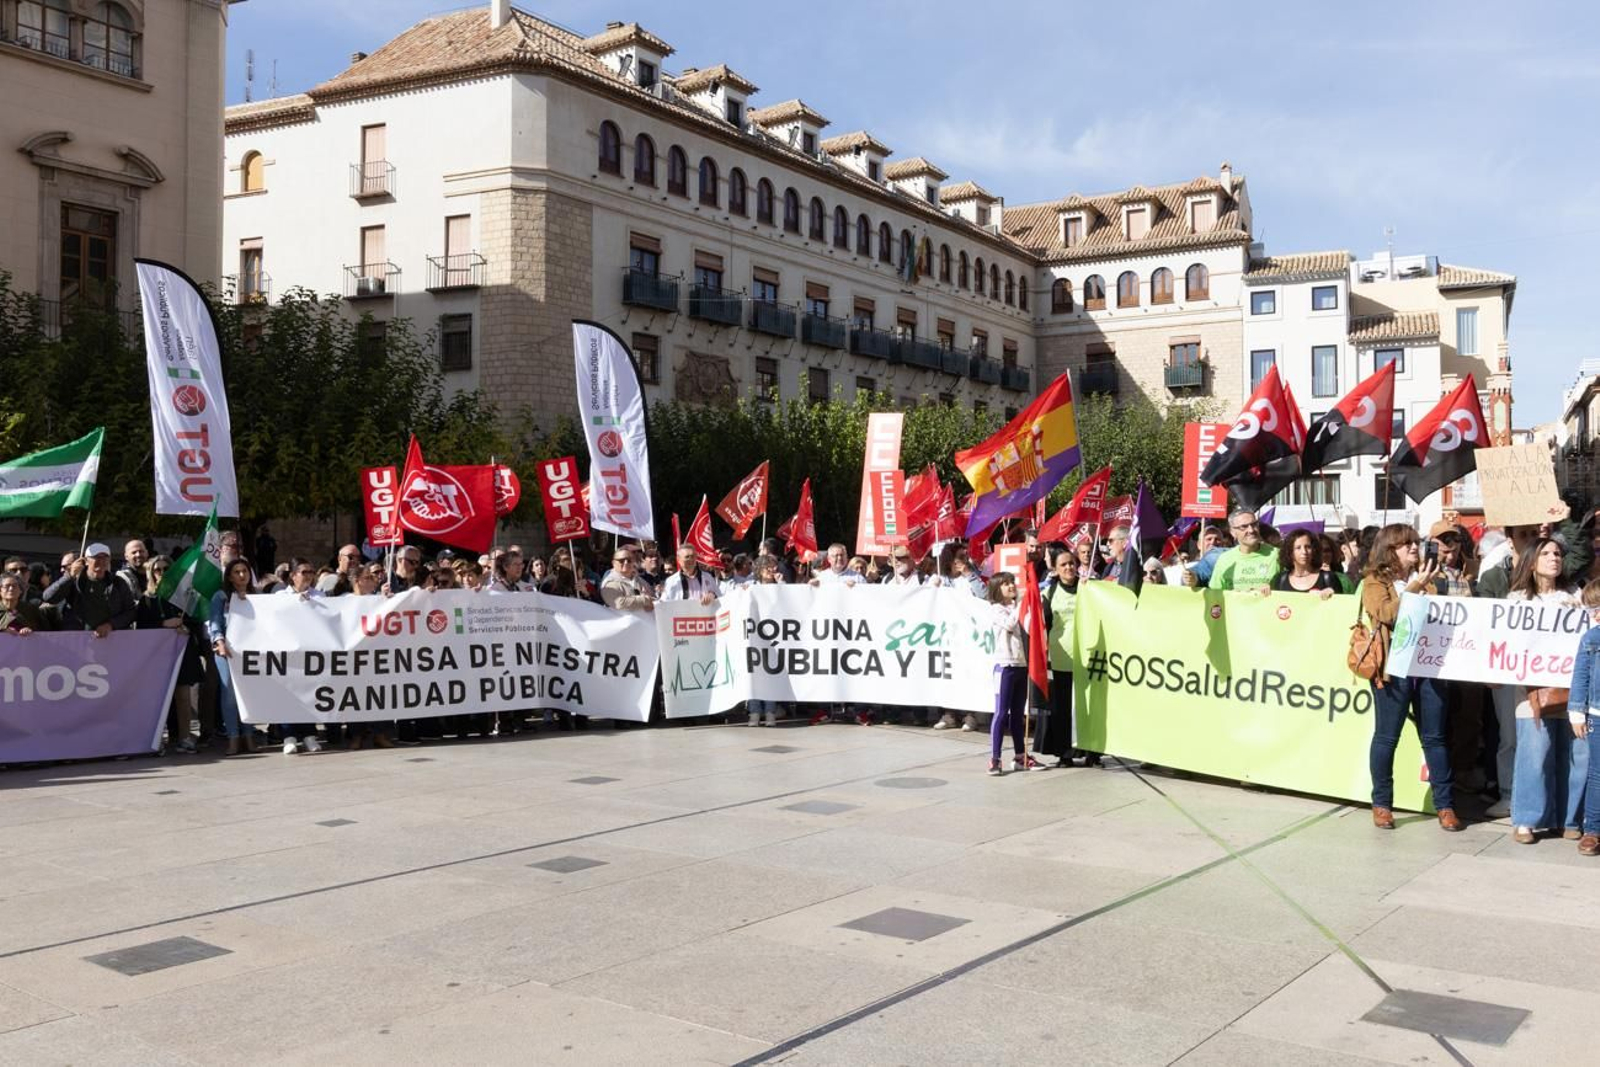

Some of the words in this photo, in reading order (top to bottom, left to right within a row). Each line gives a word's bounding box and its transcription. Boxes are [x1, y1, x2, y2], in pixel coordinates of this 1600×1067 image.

[369, 470, 394, 524] UGT
[545, 462, 576, 518] UGT
[881, 472, 896, 522] CCOO
[361, 611, 421, 636] UGT
[676, 621, 715, 632] CCOO
[743, 619, 800, 641] POR
[812, 619, 872, 641] UNA
[1427, 602, 1468, 626] DAD
[1491, 601, 1590, 634] PÚBLICA
[243, 651, 287, 675] EN
[305, 646, 458, 675] DEFENSA
[470, 643, 505, 668] DE
[747, 641, 885, 677] PÚBLICA
[896, 650, 916, 678] Y
[315, 680, 465, 711] SANIDAD
[1087, 650, 1372, 722] #SOSSaludRespo
